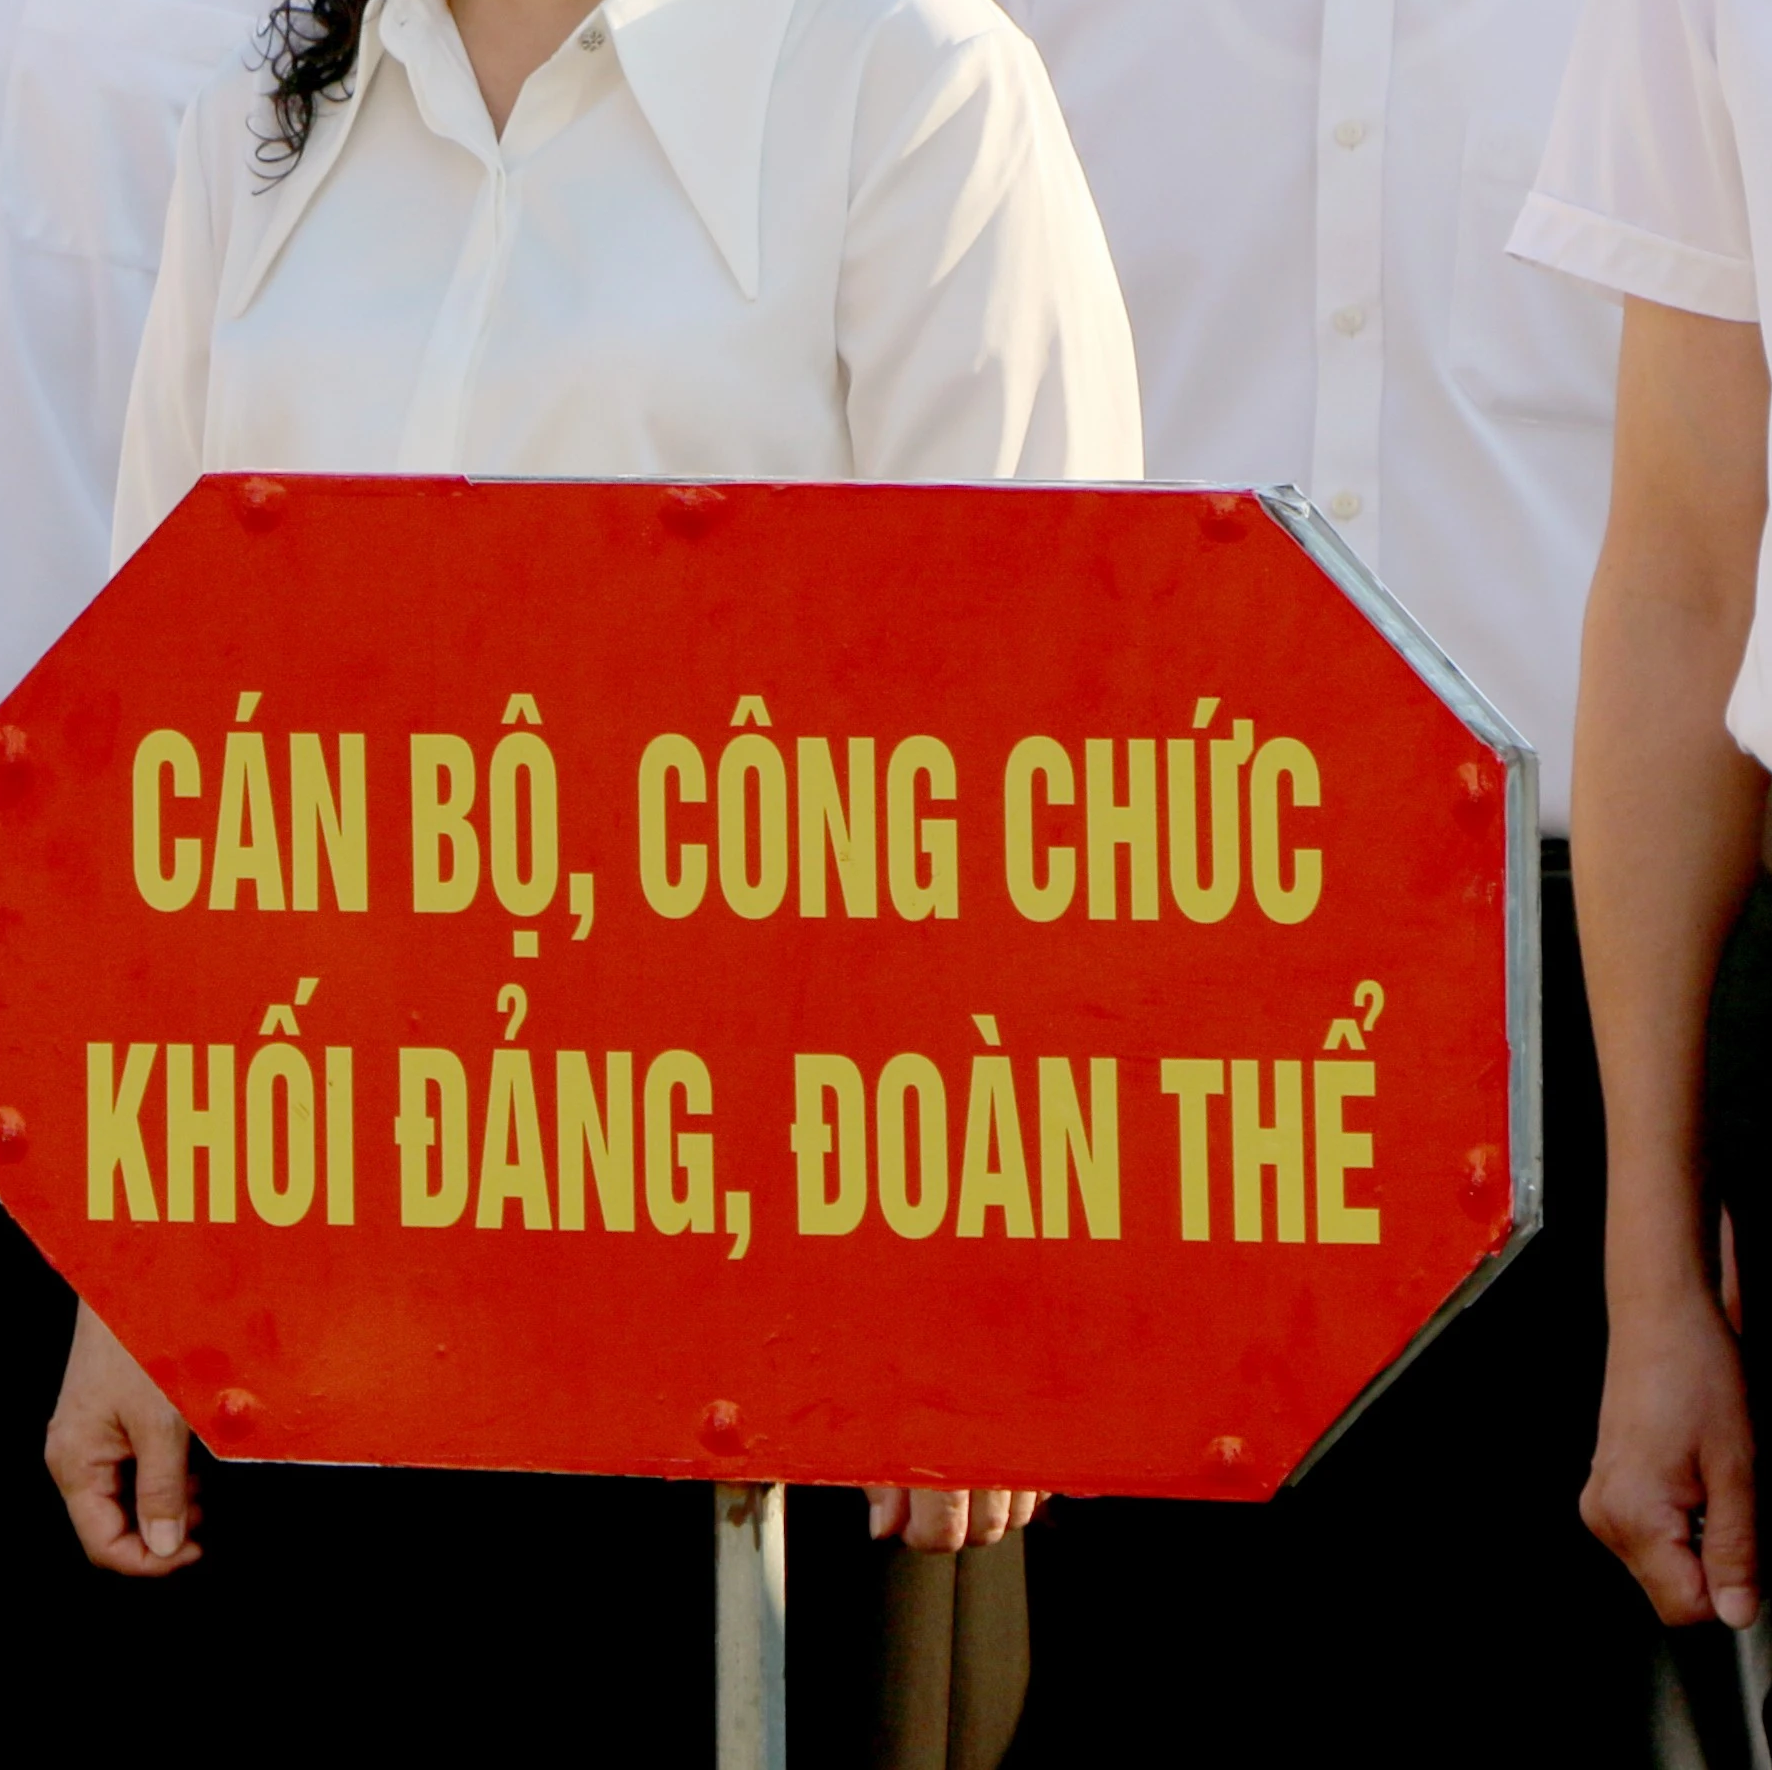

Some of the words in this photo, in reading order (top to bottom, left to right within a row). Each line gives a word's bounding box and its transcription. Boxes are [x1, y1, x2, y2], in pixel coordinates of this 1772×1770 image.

[132, 691, 369, 913] CÁN
[410, 693, 595, 958] BỘ,
[638, 695, 959, 922] CÔNG
[1004, 697, 1323, 925] CHỨC
[86, 977, 355, 1227] KHỐI
[394, 983, 751, 1260] ĐẢNG,
[790, 1014, 1121, 1240] ĐOÀN
[1160, 979, 1385, 1245] THỂ
